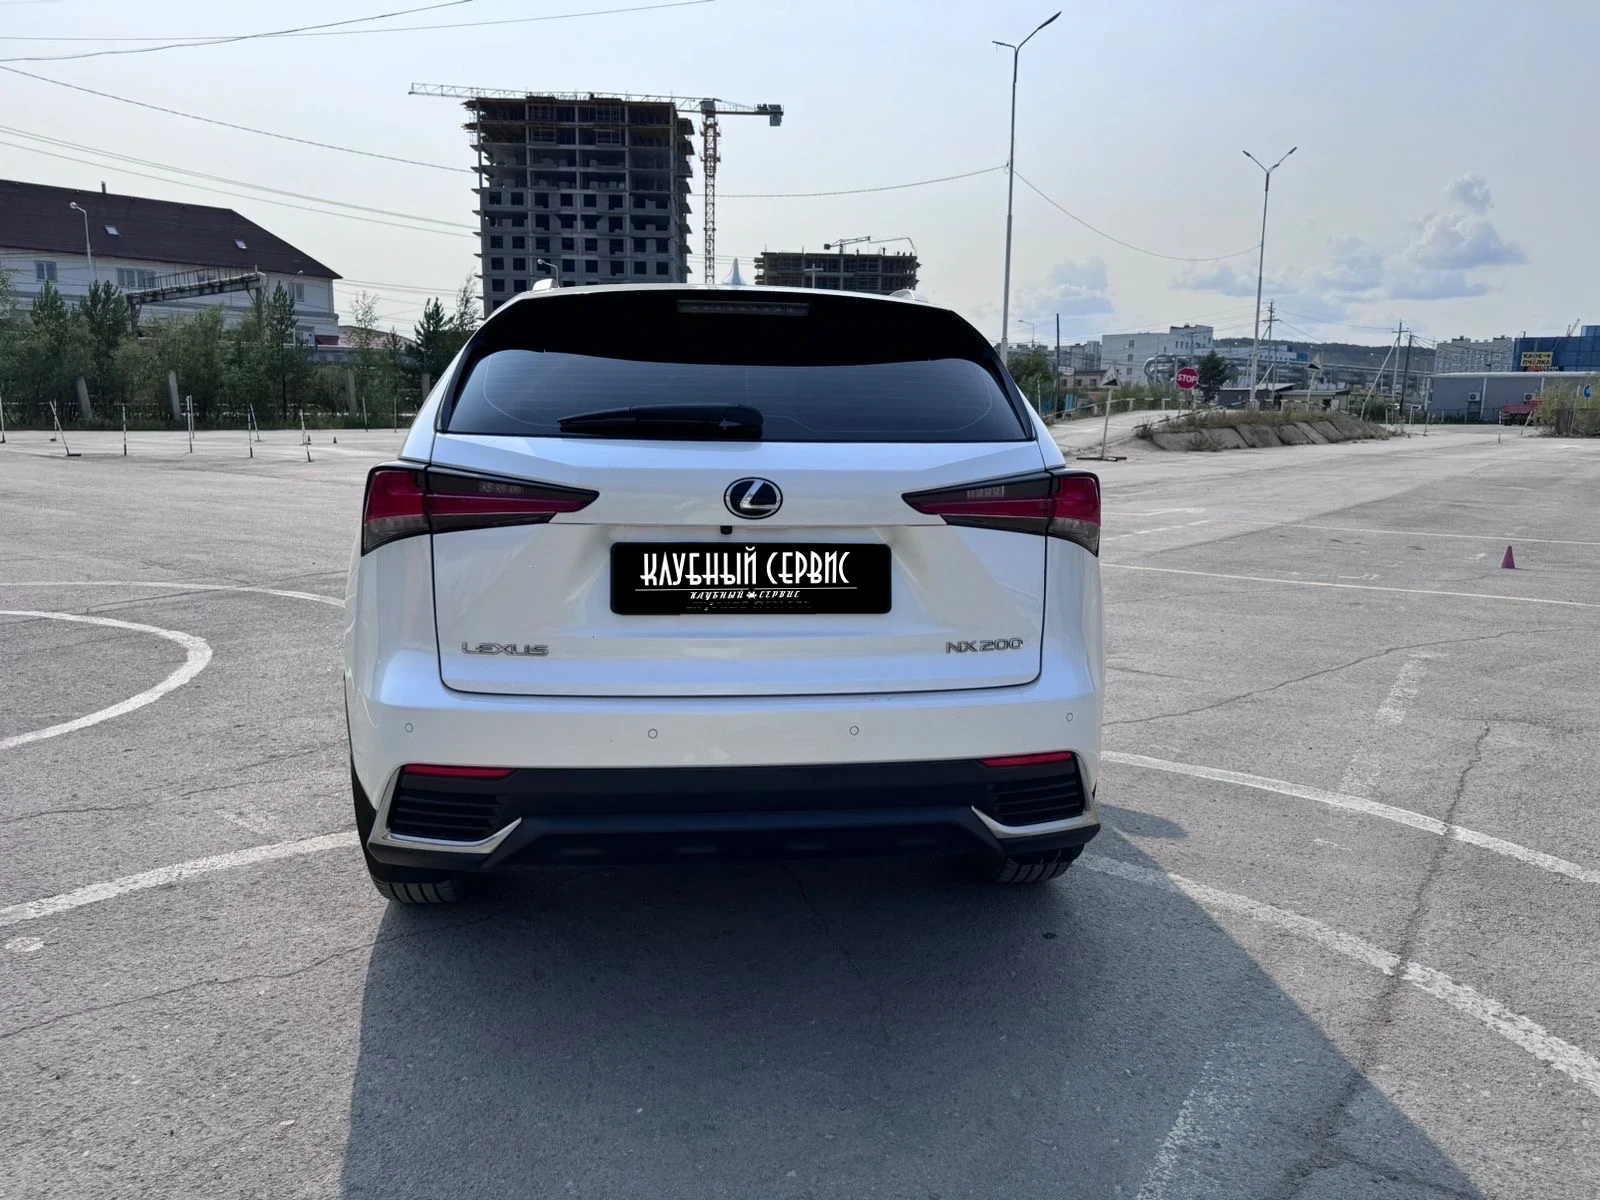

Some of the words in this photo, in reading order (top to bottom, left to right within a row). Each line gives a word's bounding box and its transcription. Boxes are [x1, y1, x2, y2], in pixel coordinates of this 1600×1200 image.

[1177, 374, 1197, 383] STOP
[461, 641, 549, 657] LEXUS
[946, 640, 978, 653] NX
[979, 637, 1024, 651] 200
